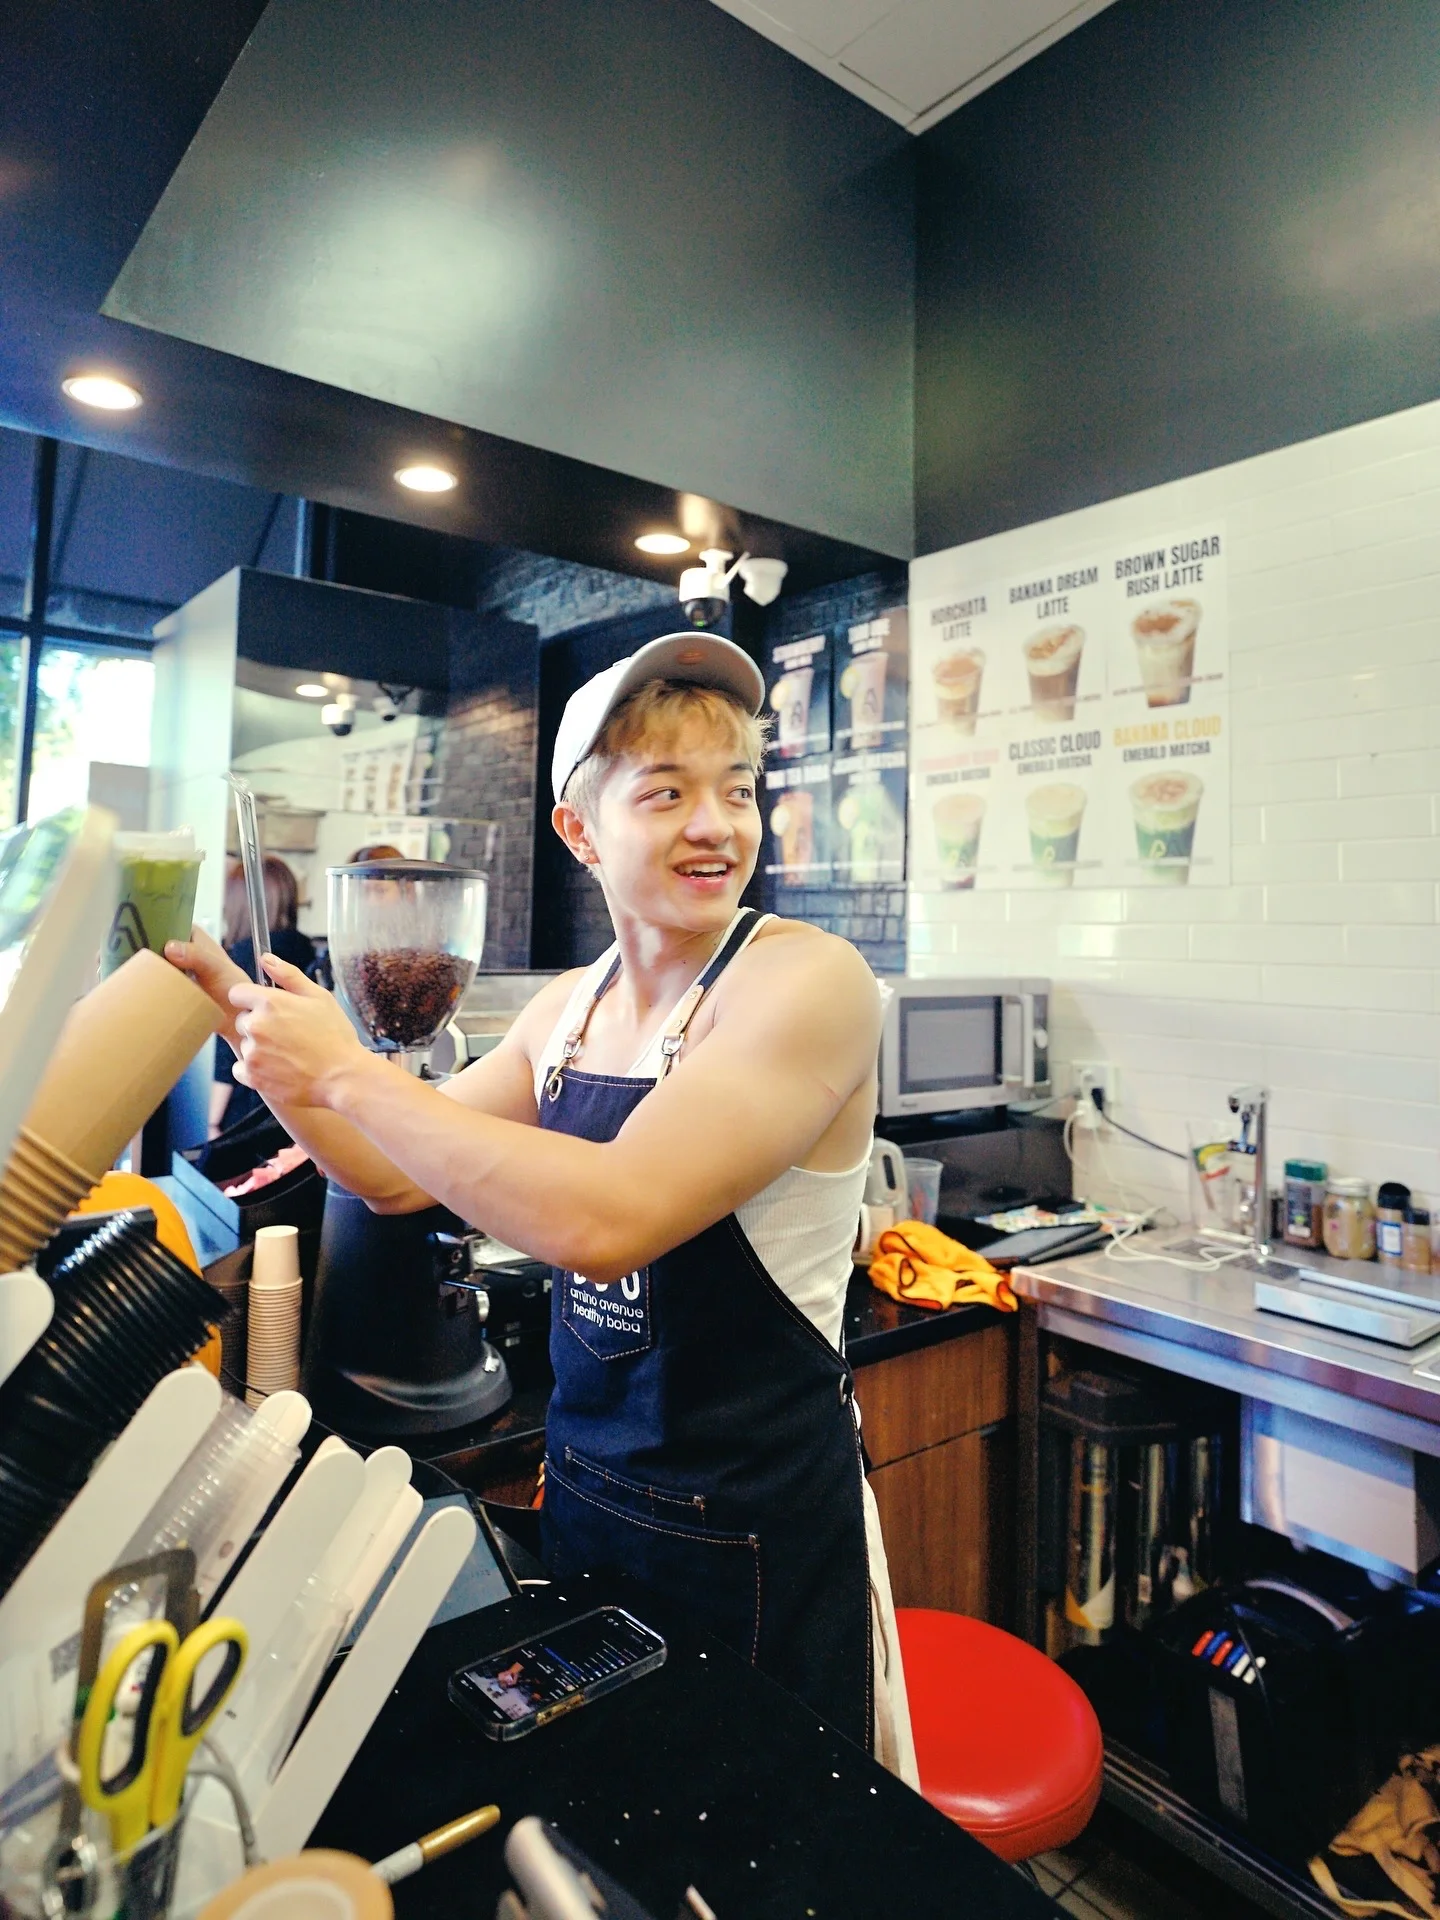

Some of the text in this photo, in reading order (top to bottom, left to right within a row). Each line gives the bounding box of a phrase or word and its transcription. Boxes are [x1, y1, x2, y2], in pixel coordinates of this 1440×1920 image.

[1115, 535, 1220, 579] BROWN SUGAR
[1009, 566, 1098, 604] BANANA DREAM
[1127, 563, 1203, 598] RUSH LATTE
[1037, 596, 1068, 619] LATTE
[942, 620, 971, 641] LATTE
[1008, 729, 1101, 761] CLASSIC CLOUD
[1112, 715, 1222, 747] BANANA CLOUD
[570, 1287, 644, 1319] amino avenue
[573, 1301, 641, 1334] healthy boba
